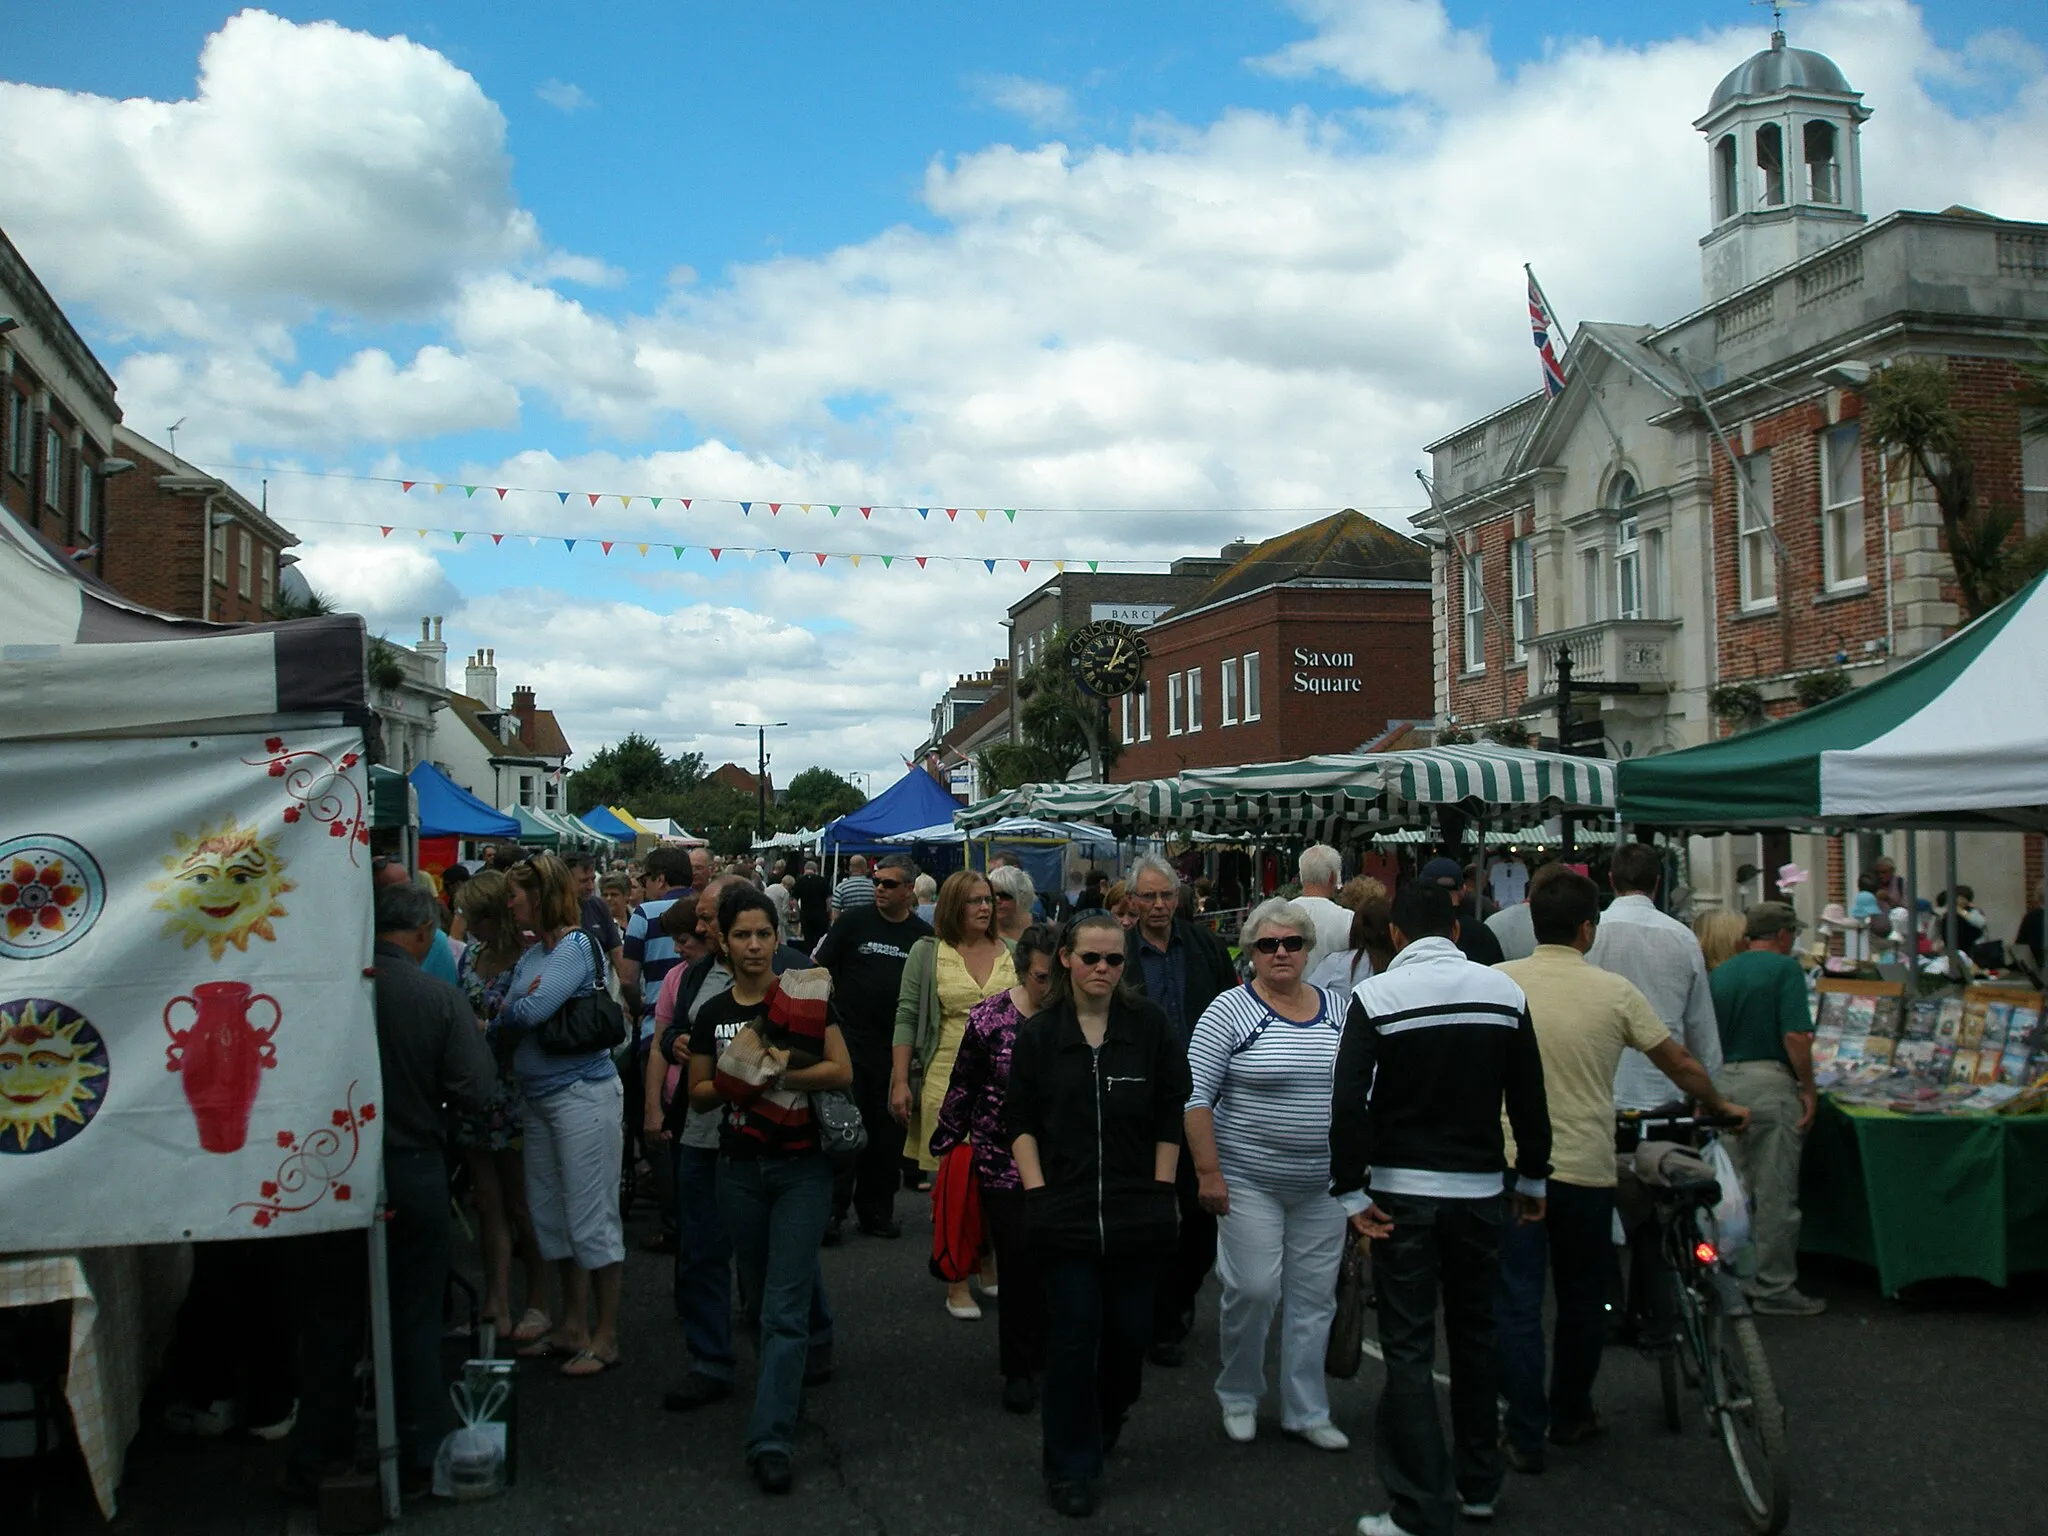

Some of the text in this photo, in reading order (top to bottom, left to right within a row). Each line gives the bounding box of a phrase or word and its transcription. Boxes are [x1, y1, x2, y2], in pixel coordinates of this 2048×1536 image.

[1112, 610, 1167, 619] BARCL
[1294, 647, 1353, 667] Saxon
[1294, 671, 1362, 695] Square
